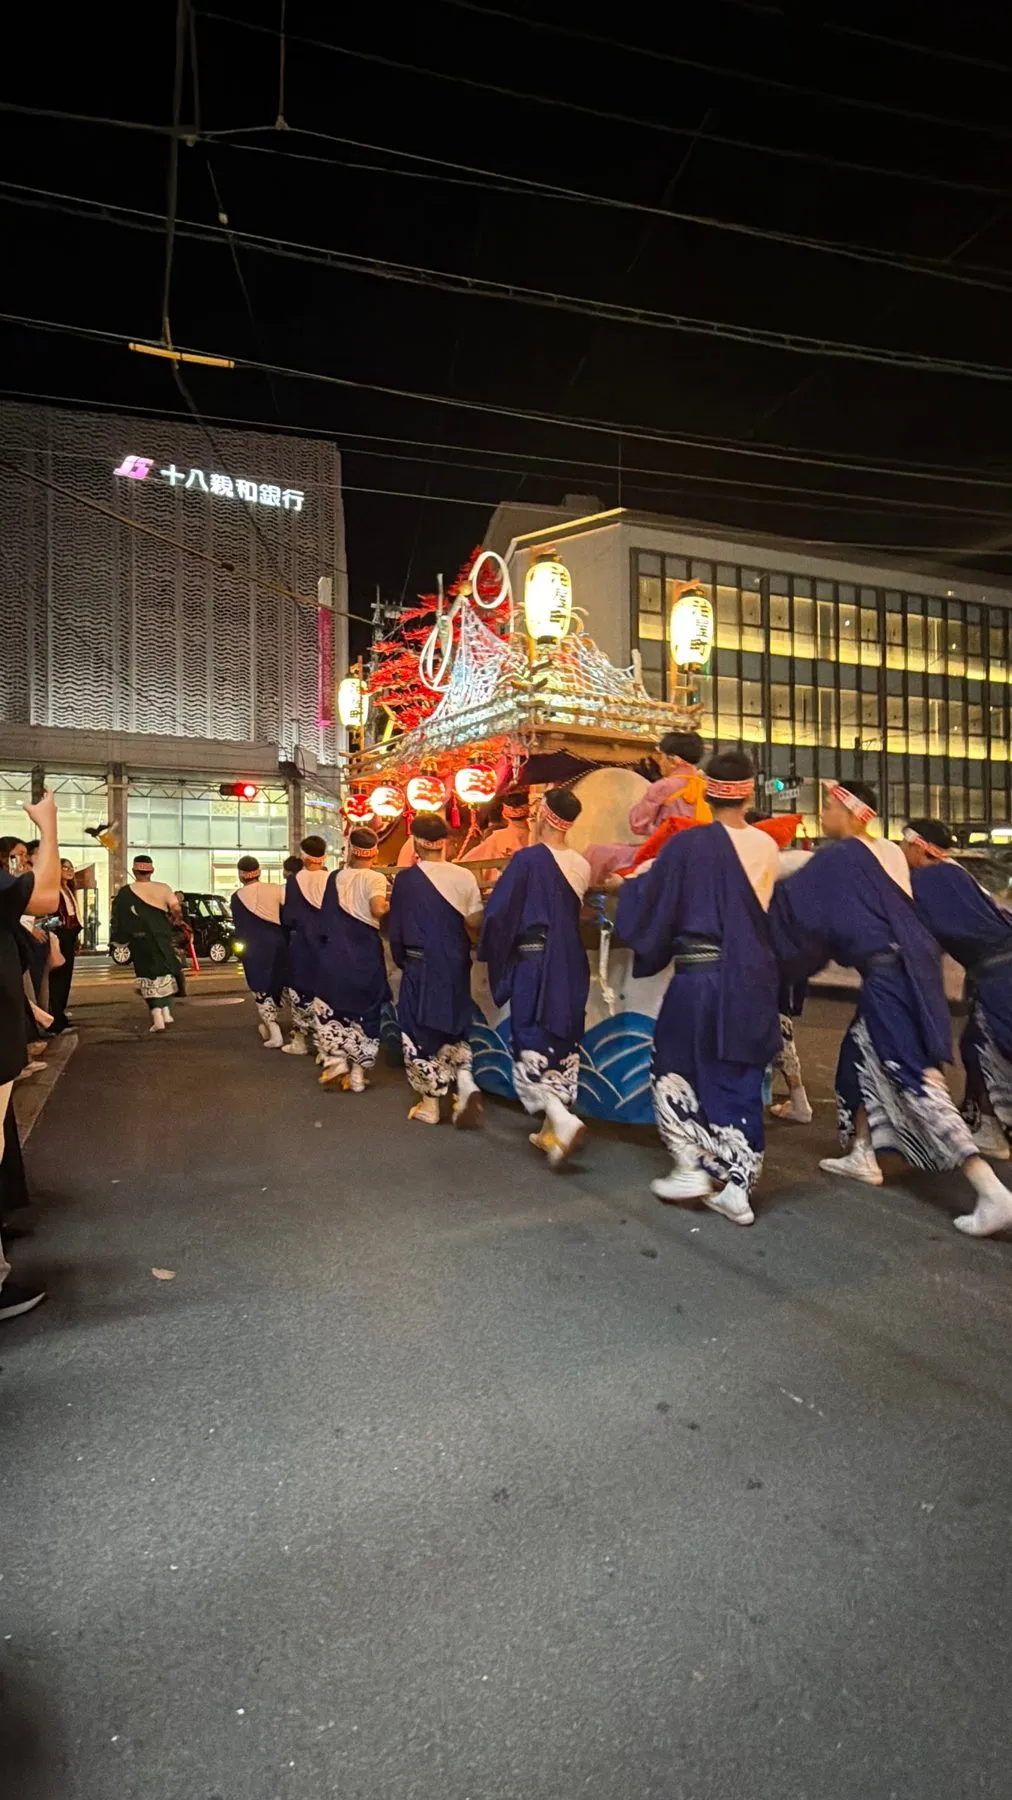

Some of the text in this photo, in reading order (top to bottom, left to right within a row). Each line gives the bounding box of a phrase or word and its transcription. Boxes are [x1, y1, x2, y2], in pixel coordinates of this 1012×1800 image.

[160, 464, 305, 511] 十八親和銀行
